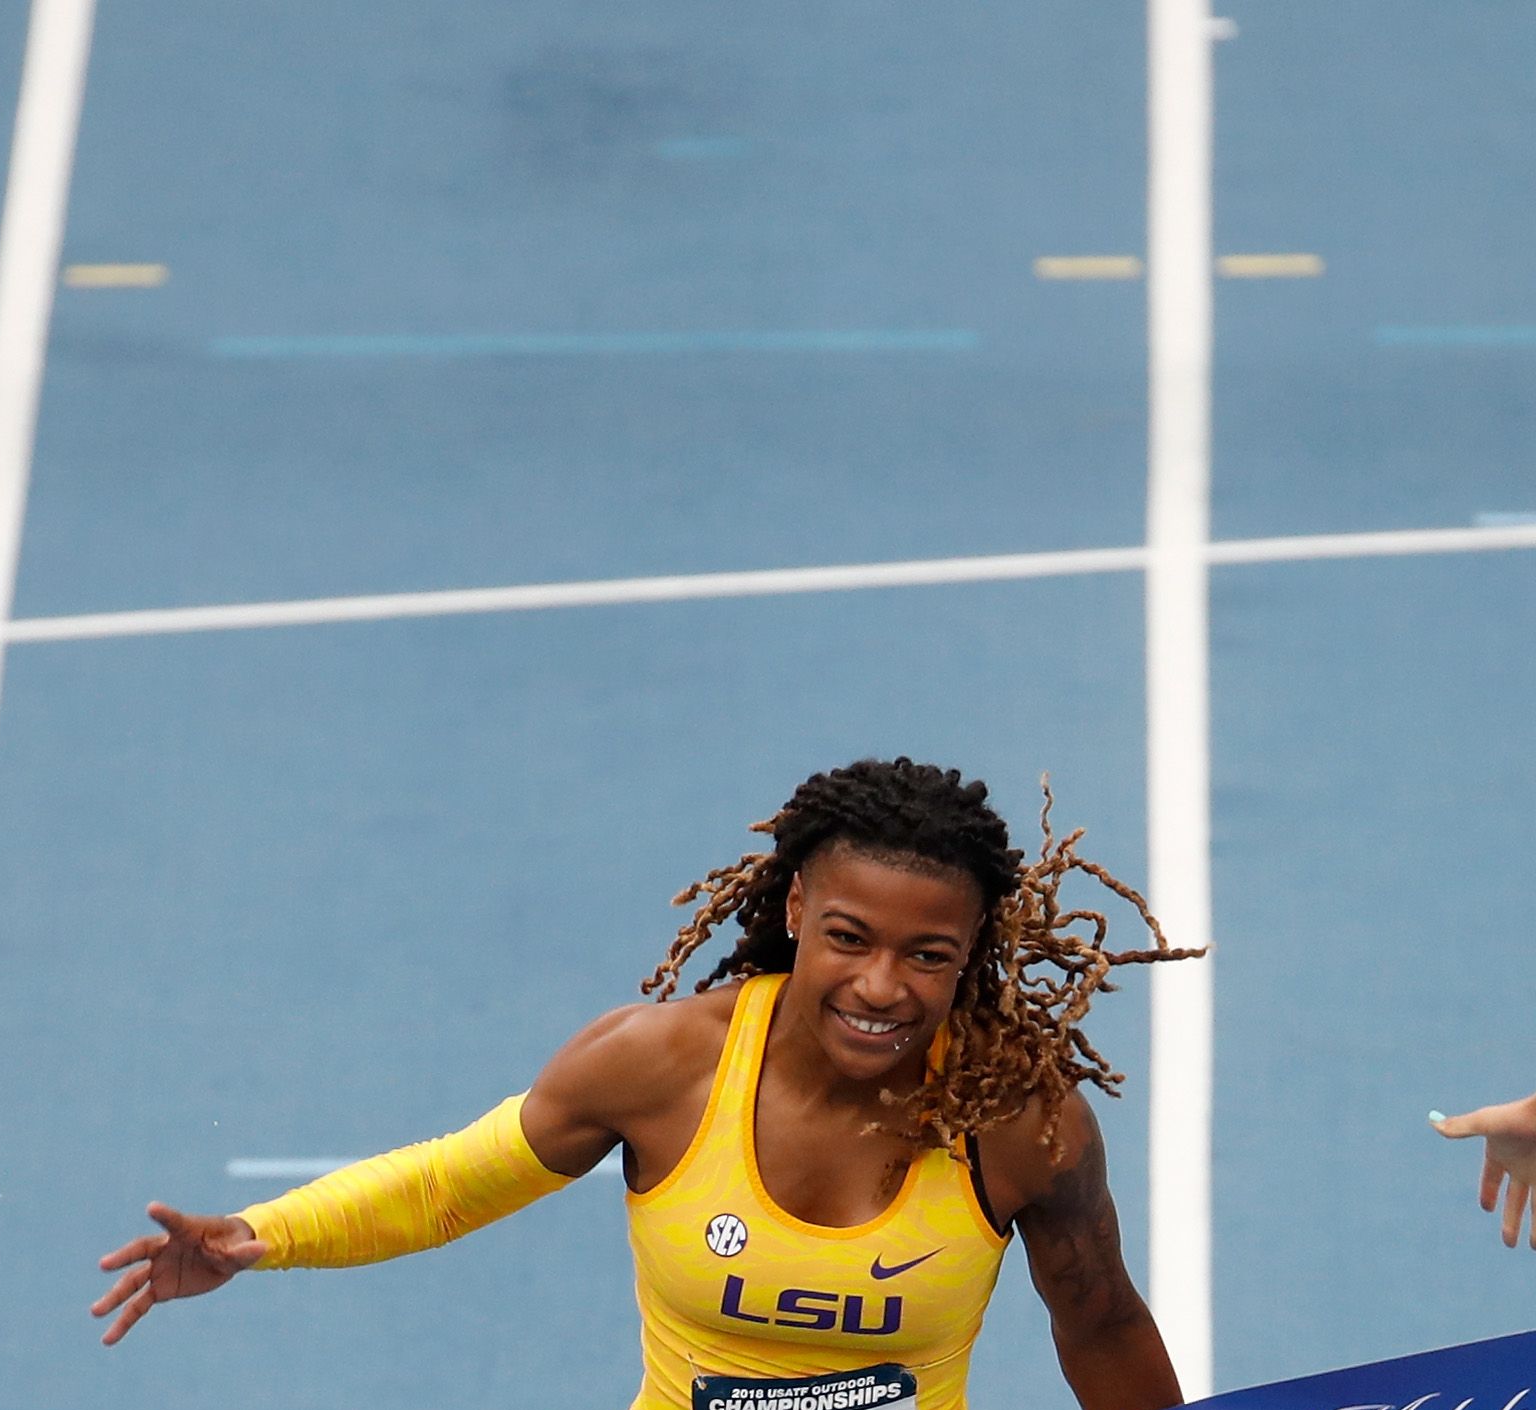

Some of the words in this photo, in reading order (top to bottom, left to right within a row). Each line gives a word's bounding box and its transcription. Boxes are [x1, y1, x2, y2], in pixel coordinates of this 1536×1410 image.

[705, 1214, 747, 1257] SEC
[720, 1275, 903, 1335] LSU
[731, 1388, 764, 1399] 2018
[767, 1387, 809, 1398] USATF
[812, 1376, 876, 1396] OUTDOOR
